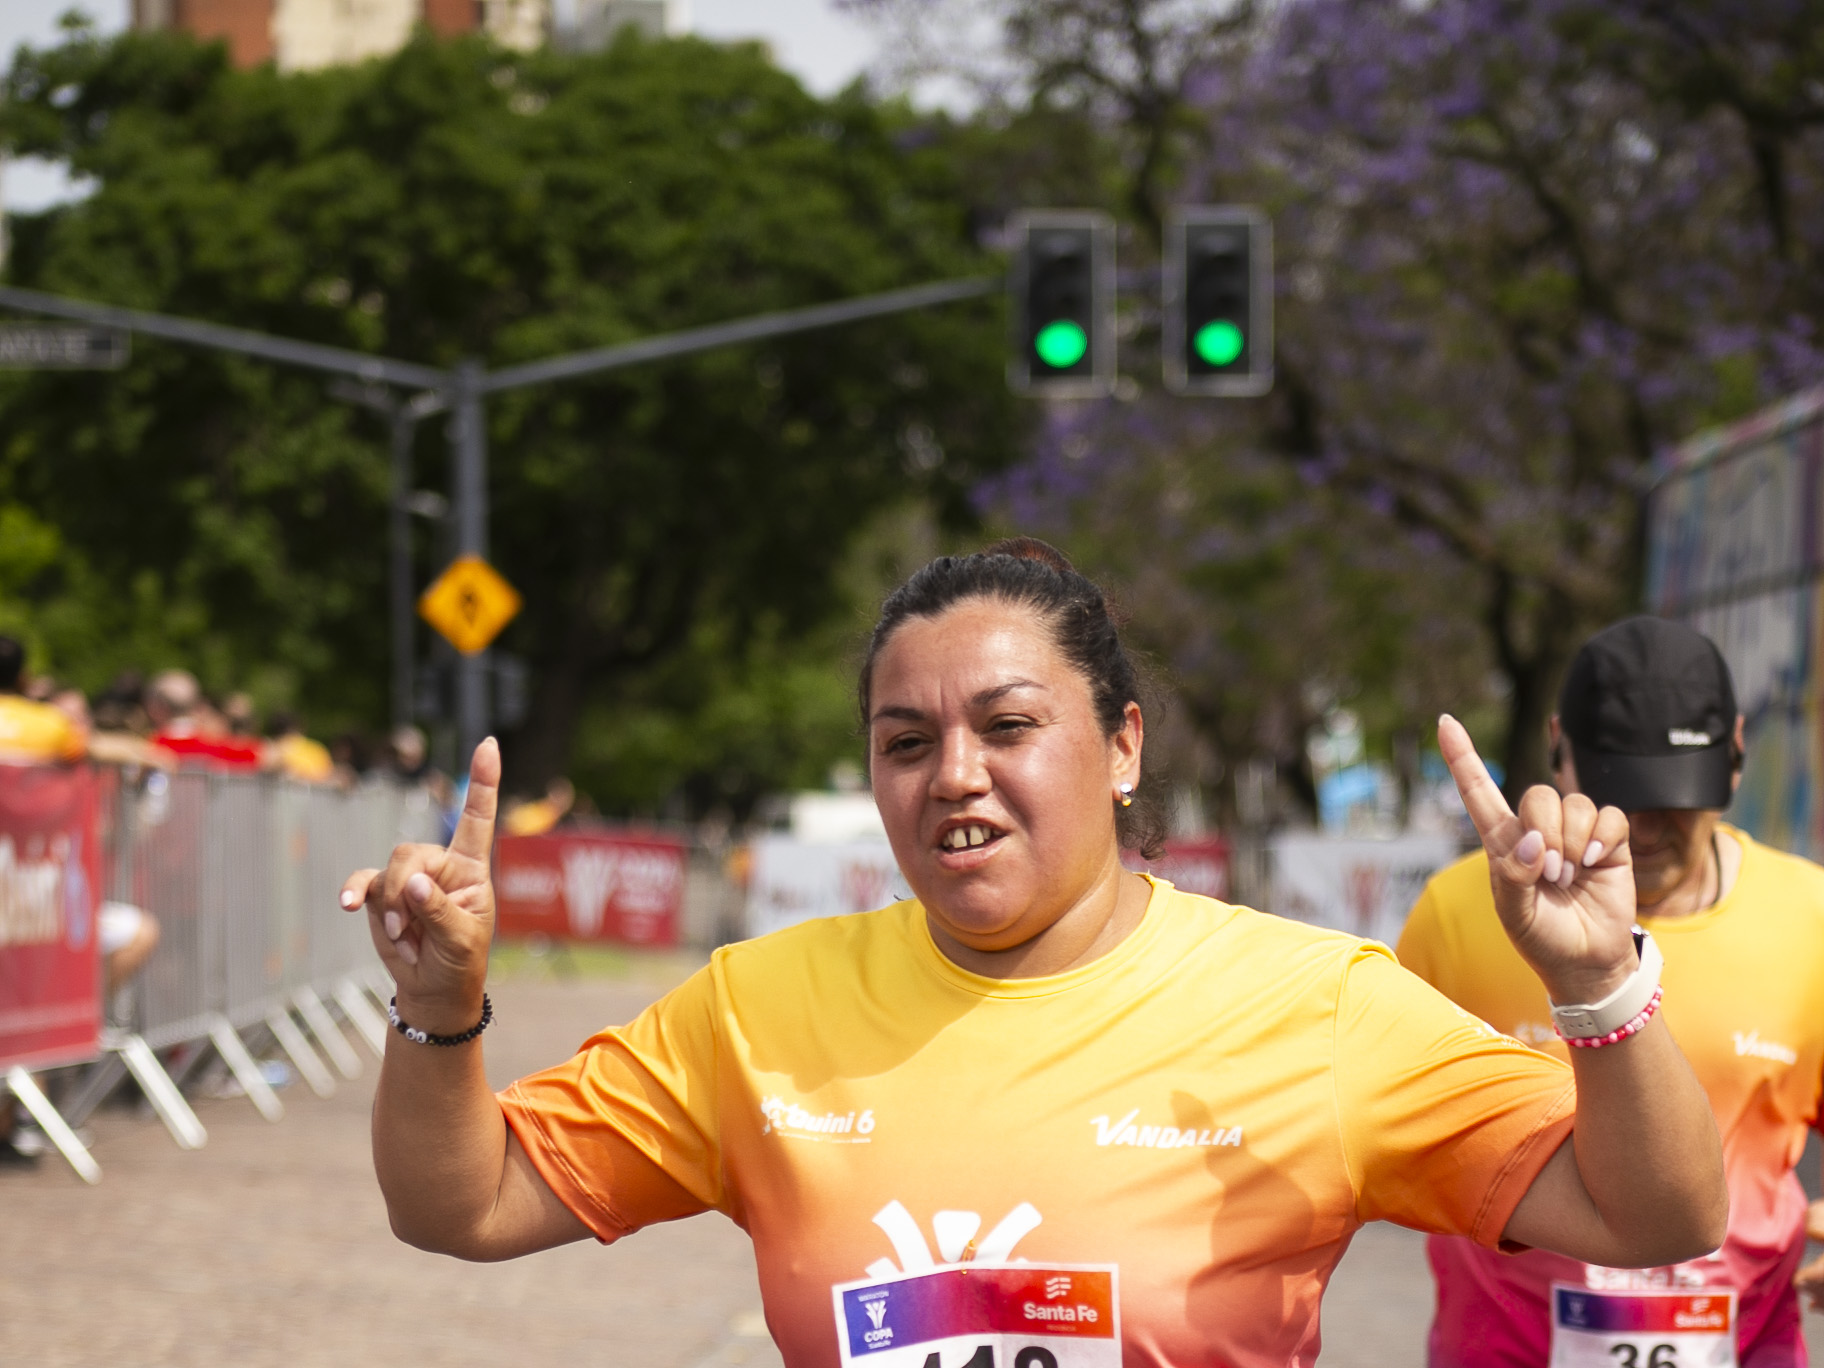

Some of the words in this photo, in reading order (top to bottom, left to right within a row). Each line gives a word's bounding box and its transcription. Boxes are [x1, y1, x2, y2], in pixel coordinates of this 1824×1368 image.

[856, 1109, 876, 1135] 6
[1023, 1302, 1076, 1322] Santa
[1076, 1305, 1098, 1323] Fe
[864, 1327, 894, 1343] COPA
